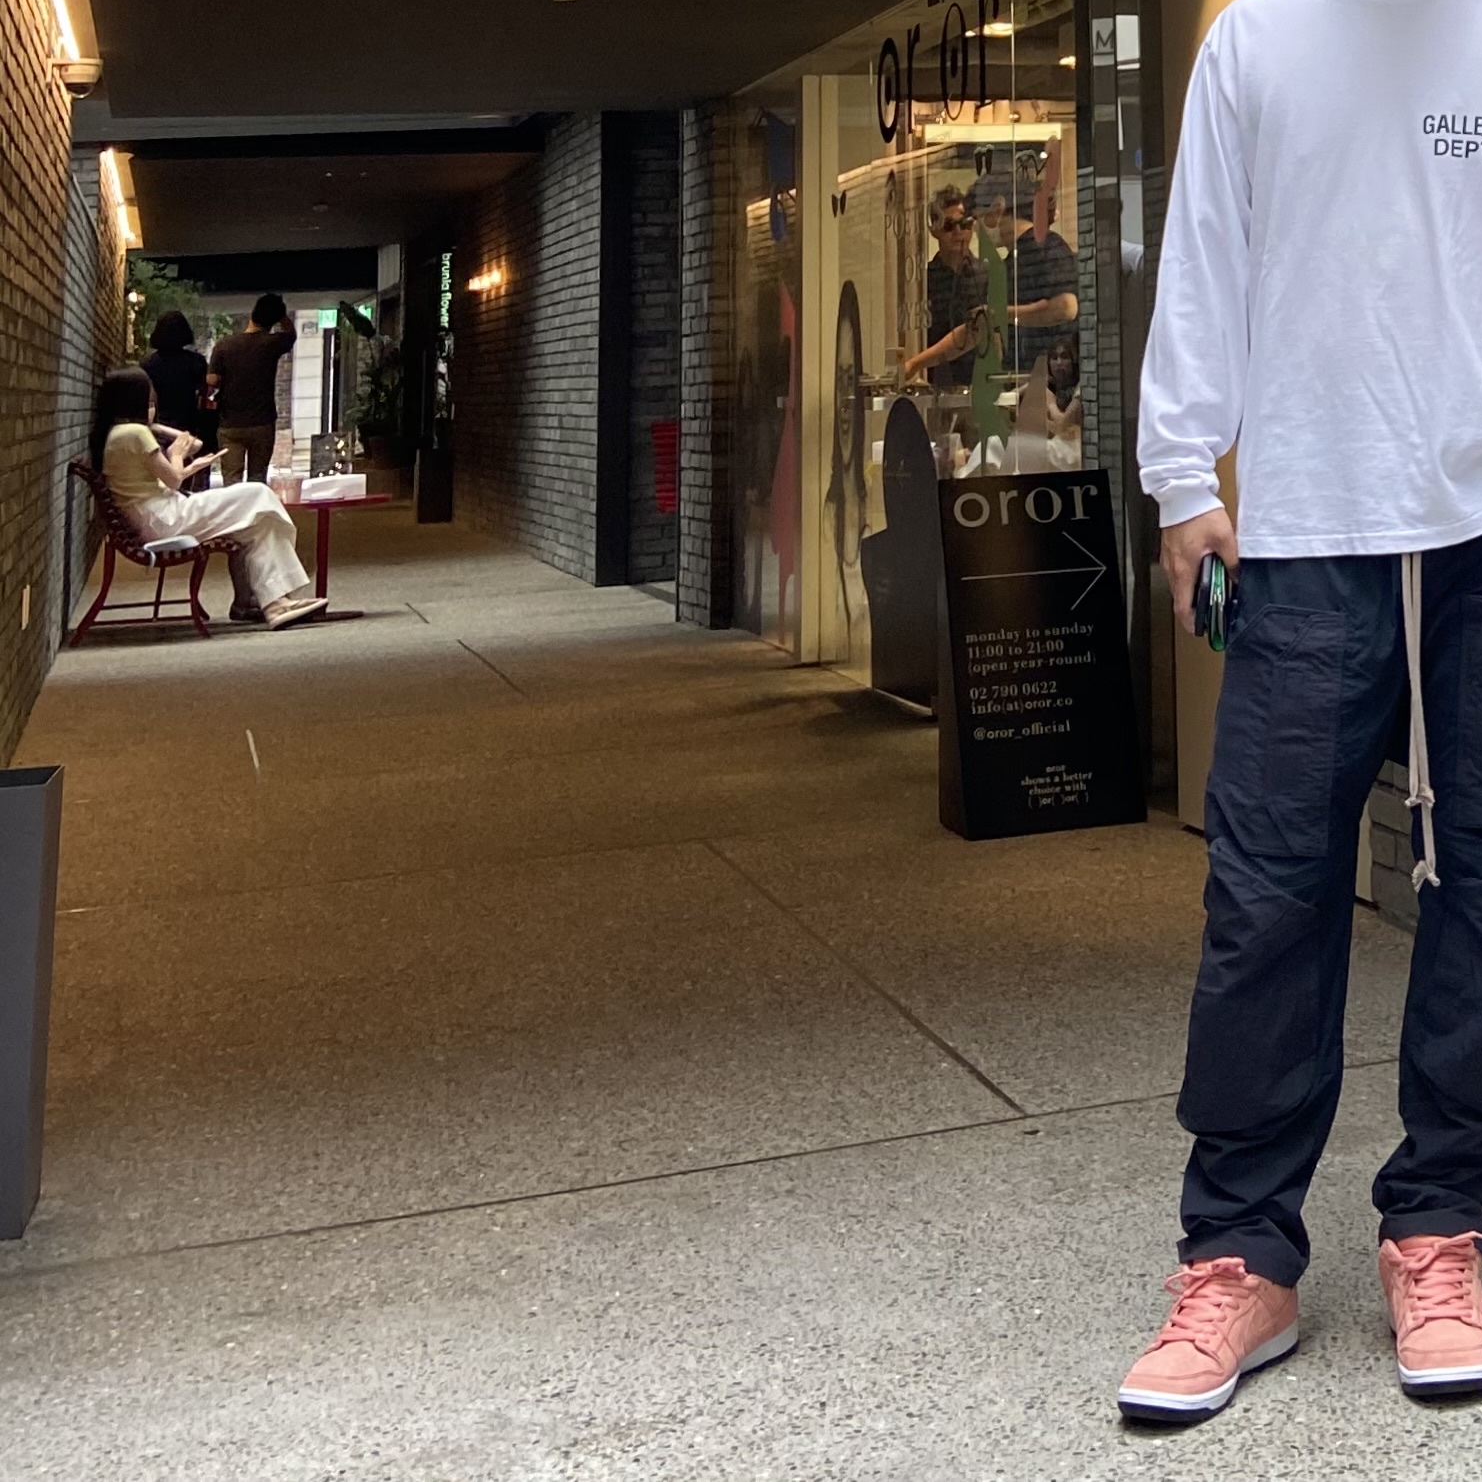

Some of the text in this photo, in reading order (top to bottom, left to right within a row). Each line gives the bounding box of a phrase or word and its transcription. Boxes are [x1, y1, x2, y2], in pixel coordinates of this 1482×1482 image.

[953, 484, 1099, 528] oror
[965, 622, 1094, 643] monday to sunday
[968, 639, 1064, 659] 11:00 to 21:00
[968, 660, 1009, 677] (open
[969, 687, 988, 700] 02
[1022, 681, 1057, 696] 0622
[971, 697, 1073, 714] info(at)oror.co
[973, 719, 1071, 740] @oror_official
